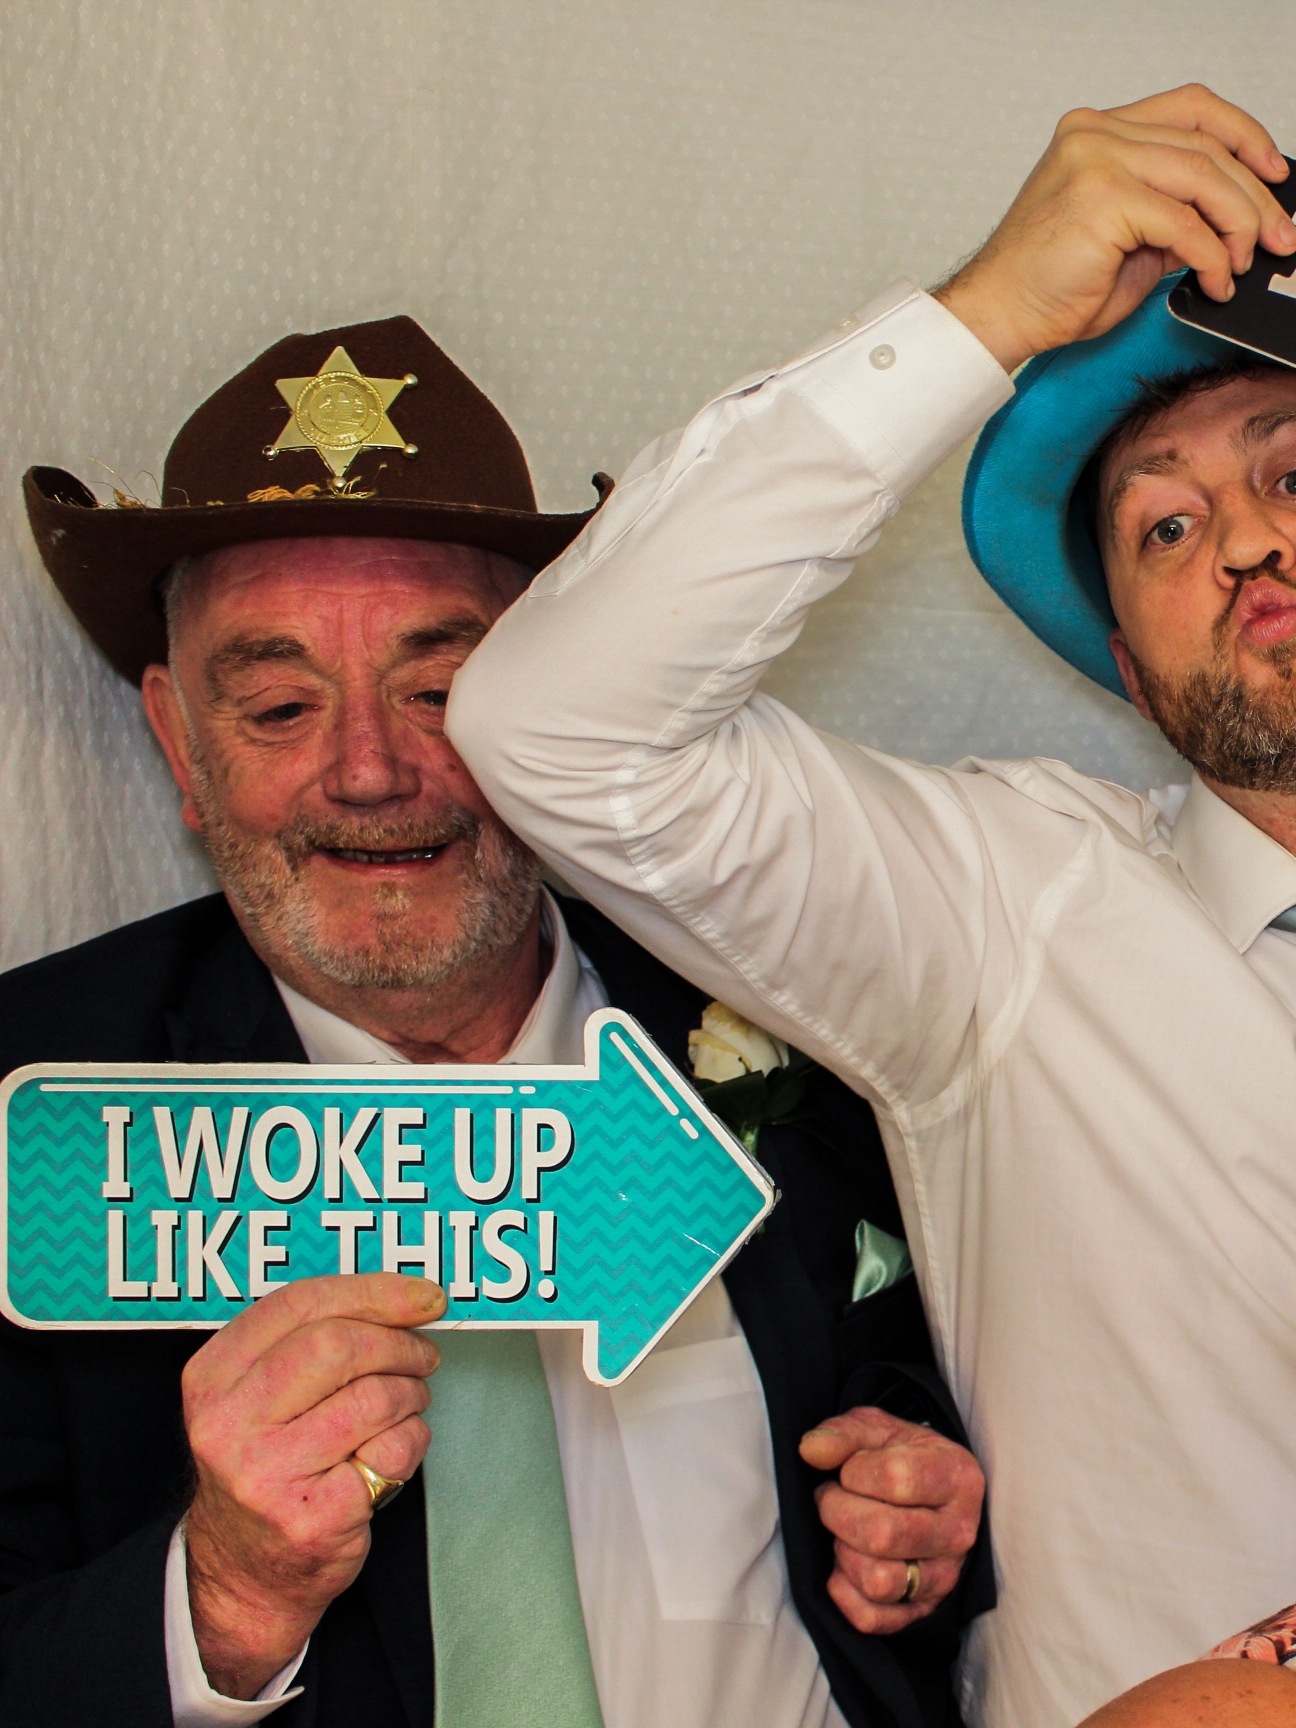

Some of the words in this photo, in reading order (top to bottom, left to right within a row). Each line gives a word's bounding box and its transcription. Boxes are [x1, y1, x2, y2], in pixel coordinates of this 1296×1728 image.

[101, 1105, 134, 1200] I
[153, 1105, 429, 1202] WOKE
[453, 1106, 575, 1202] UP
[108, 1209, 290, 1299] LIKE
[320, 1209, 557, 1300] THIS!
